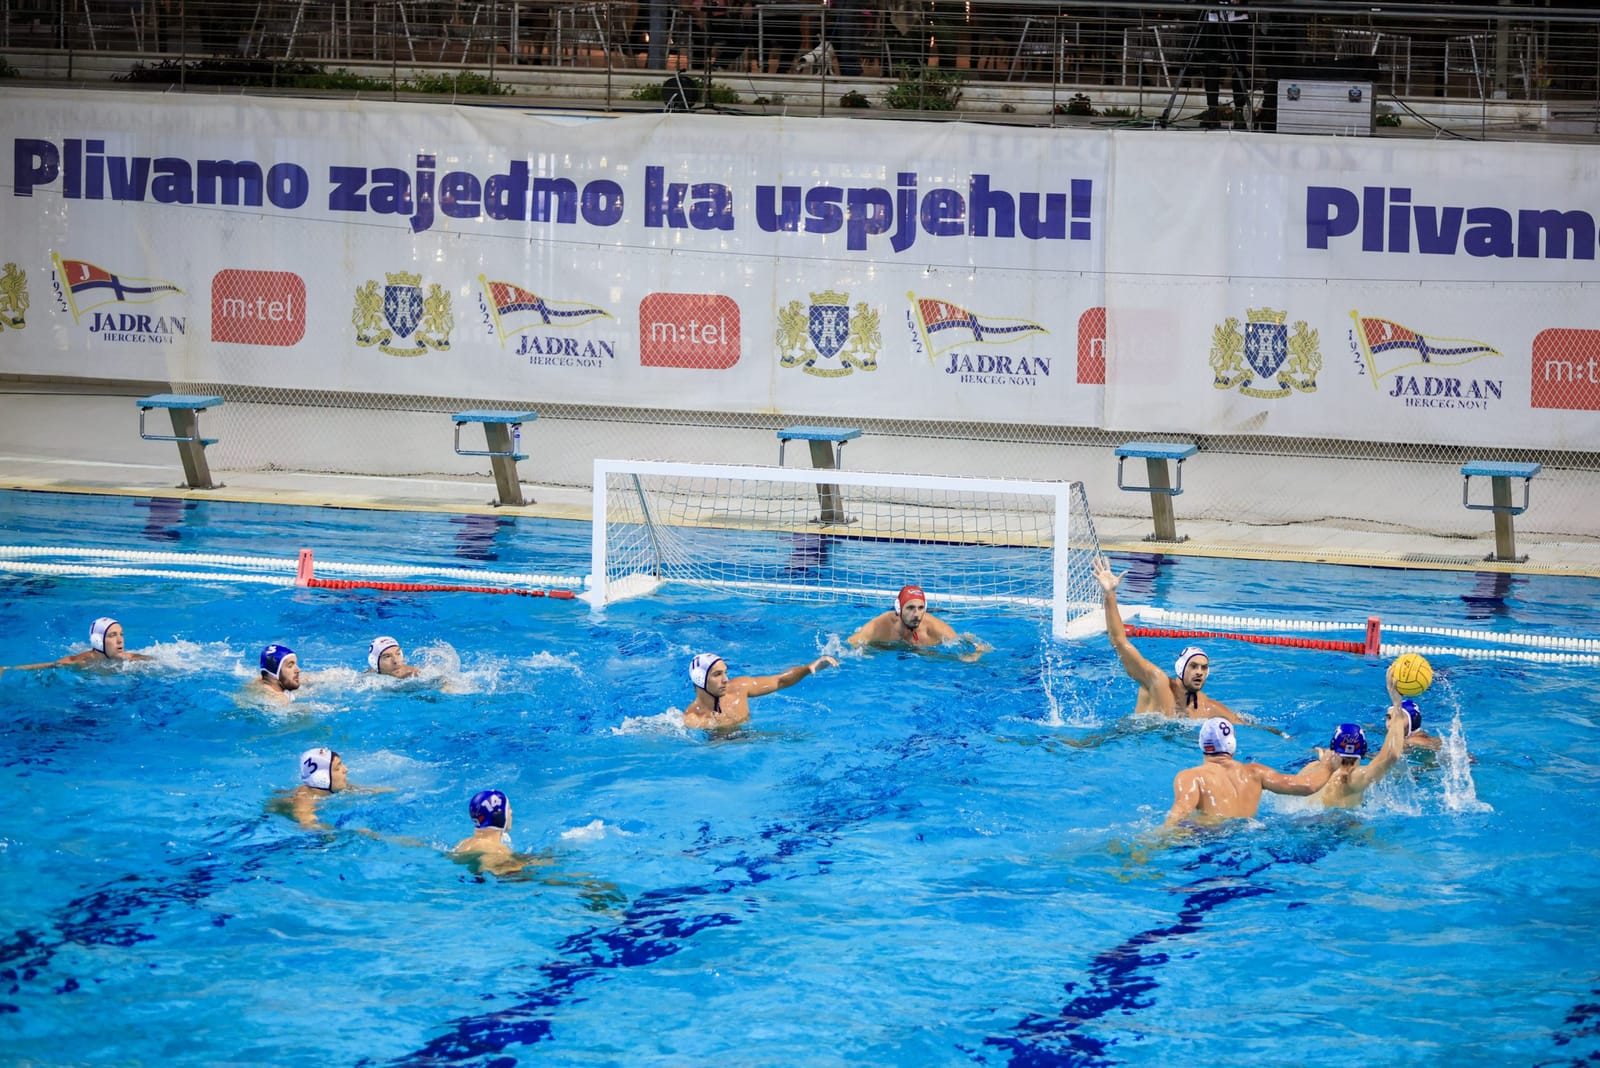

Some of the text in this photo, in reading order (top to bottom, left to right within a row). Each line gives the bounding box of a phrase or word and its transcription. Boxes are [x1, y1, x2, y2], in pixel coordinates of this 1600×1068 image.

[14, 138, 1093, 253] Plivamo zajedno ka uspjehu!
[1306, 186, 1600, 260] Plivam
[80, 264, 91, 280] J
[222, 293, 294, 321] m:tel
[89, 312, 186, 335] JADRAN
[651, 318, 727, 346] m:tel
[103, 332, 146, 343] HERCEG
[515, 335, 616, 359] JADRAN
[530, 356, 603, 368] HERCEG NOVI
[945, 353, 1052, 377] JADRAN
[1544, 356, 1600, 384] m:t
[960, 374, 1036, 386] HERCEG NOVI
[1389, 375, 1503, 400] JADRAN
[1405, 397, 1455, 409] HERCEG
[1219, 721, 1231, 737] 8
[303, 757, 319, 775] 3
[481, 794, 502, 813] 14
